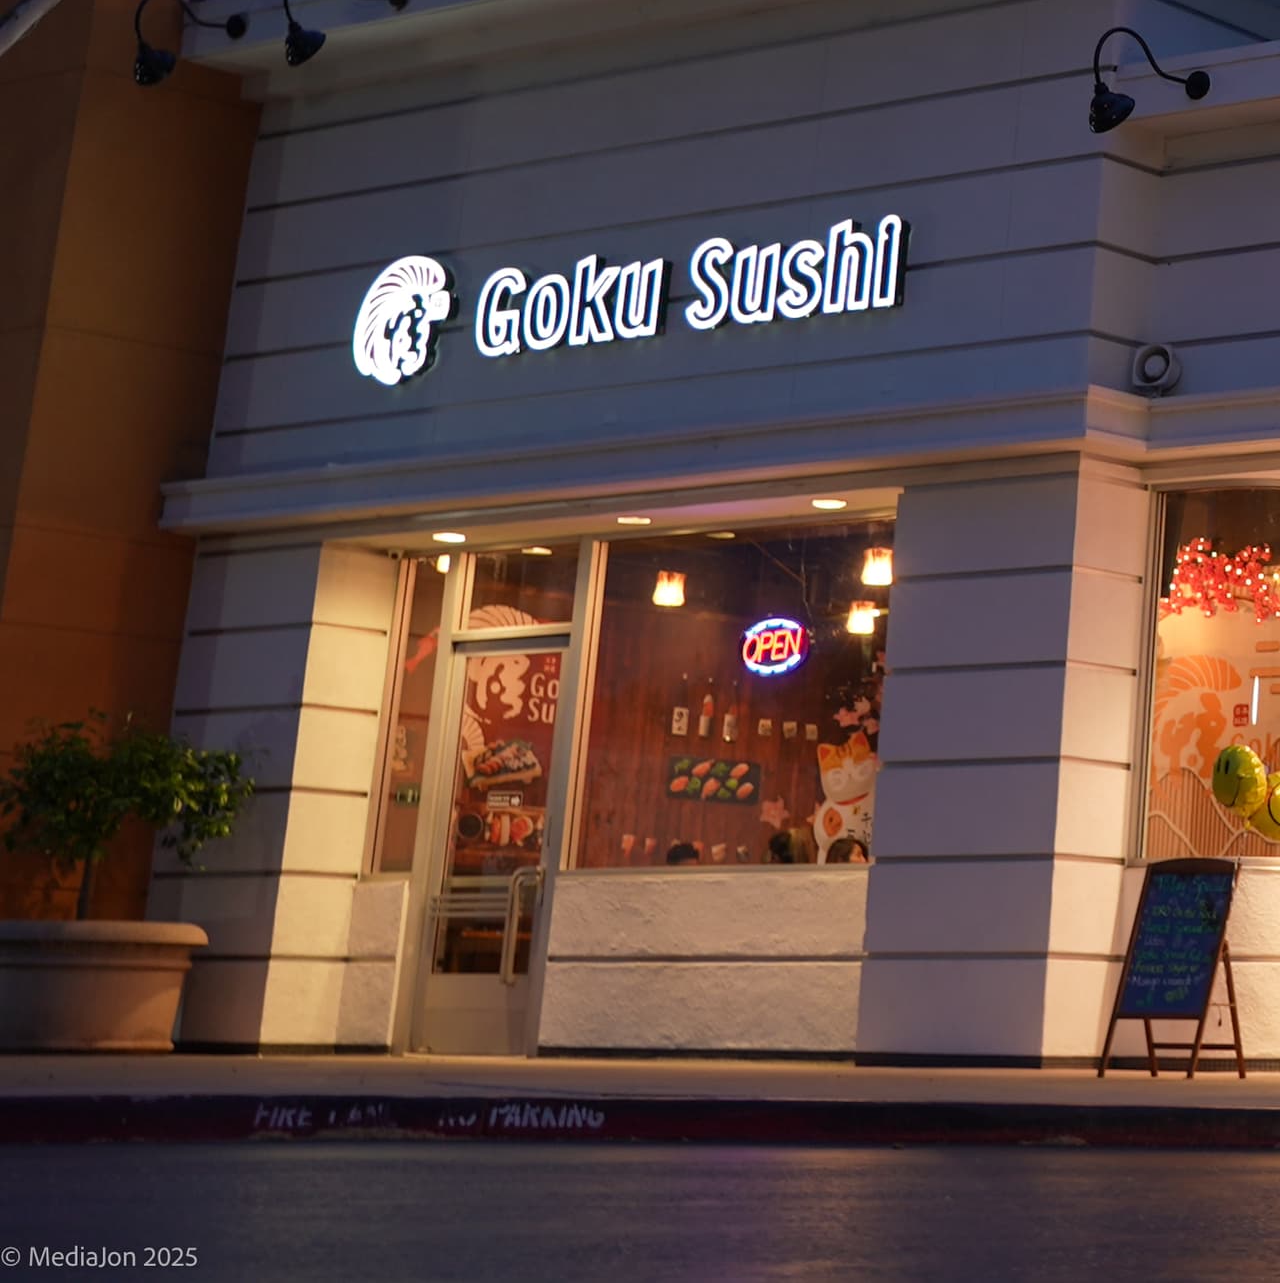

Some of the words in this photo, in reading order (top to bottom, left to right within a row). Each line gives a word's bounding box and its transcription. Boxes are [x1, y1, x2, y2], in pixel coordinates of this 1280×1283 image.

[476, 254, 665, 357] Goku
[686, 214, 902, 329] Sushi
[743, 626, 803, 663] OPEN
